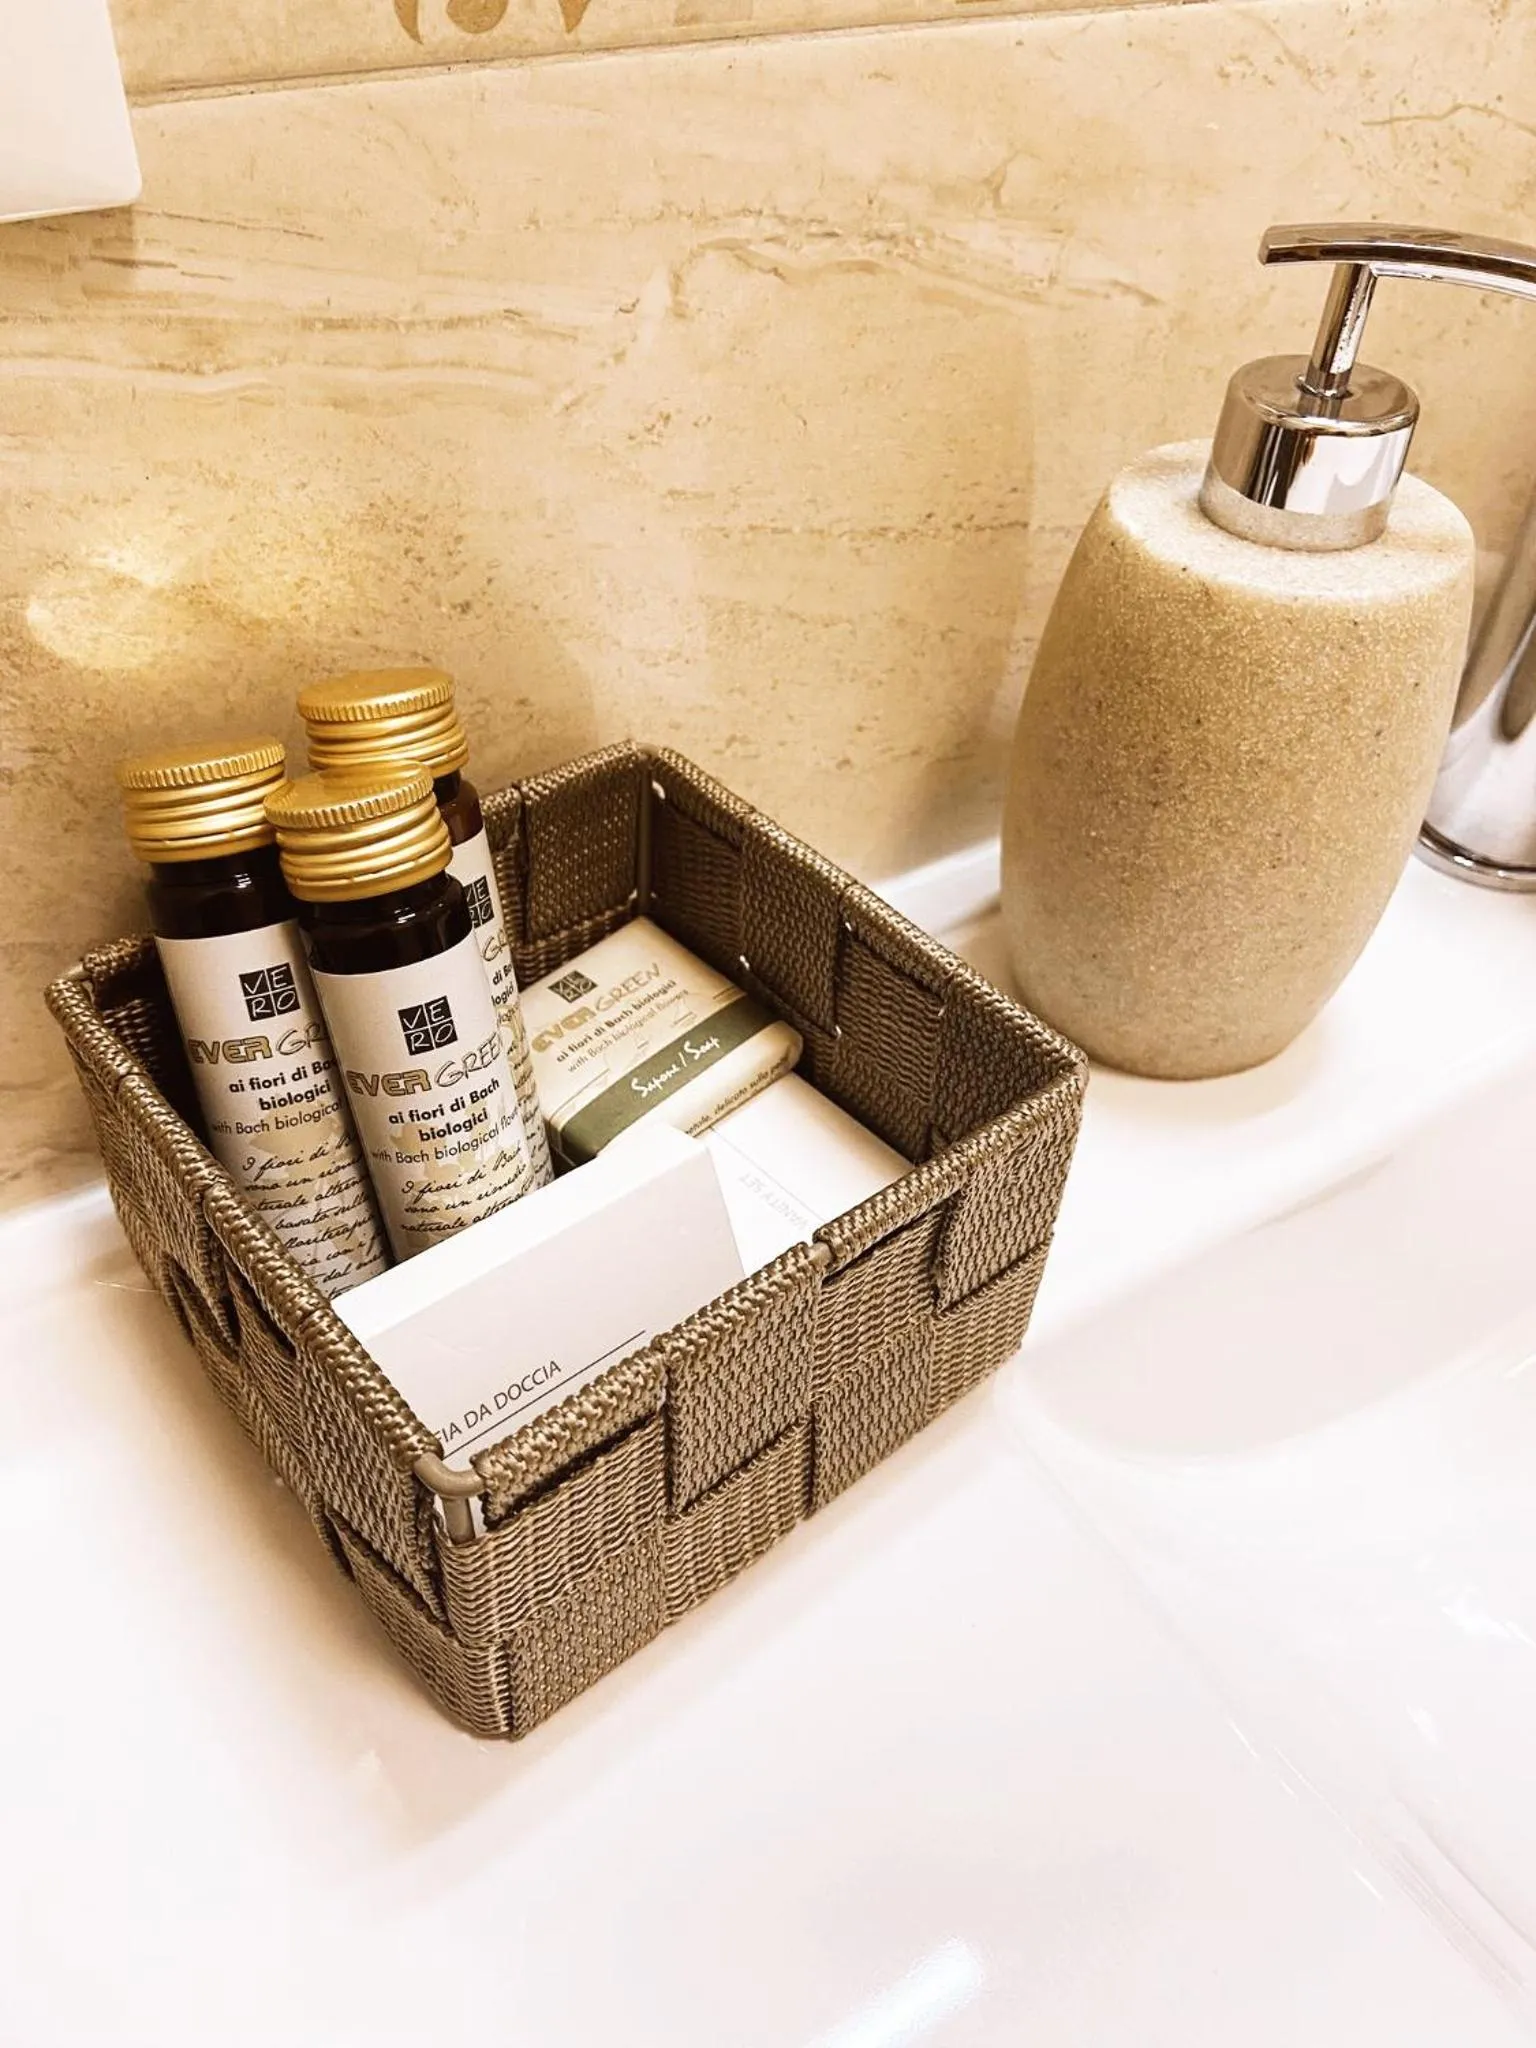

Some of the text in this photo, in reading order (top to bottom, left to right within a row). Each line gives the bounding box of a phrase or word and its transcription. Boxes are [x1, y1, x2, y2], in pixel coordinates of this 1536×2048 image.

[595, 962, 661, 1012] GREEN
[556, 979, 678, 1063] ai fiori di Bach biologici
[589, 1039, 614, 1058] Bach
[631, 1063, 681, 1098] Sapone
[684, 1036, 720, 1060] Soap
[229, 1079, 245, 1093] ai
[248, 1071, 287, 1091] fiori
[291, 1065, 308, 1082] di
[258, 1079, 332, 1111] biologici
[389, 1077, 501, 1124] ai fiori di Bach
[235, 1117, 270, 1135] Bach
[395, 1151, 430, 1164] Bach
[435, 1122, 499, 1160] biological
[419, 1107, 488, 1142] biologici
[254, 1150, 304, 1181] fiori
[309, 1142, 329, 1161] di
[253, 1194, 309, 1211] turale
[413, 1174, 462, 1204] fiori
[467, 1164, 487, 1185] di
[463, 1403, 493, 1429] DA
[493, 1360, 562, 1410] DOCCIA
